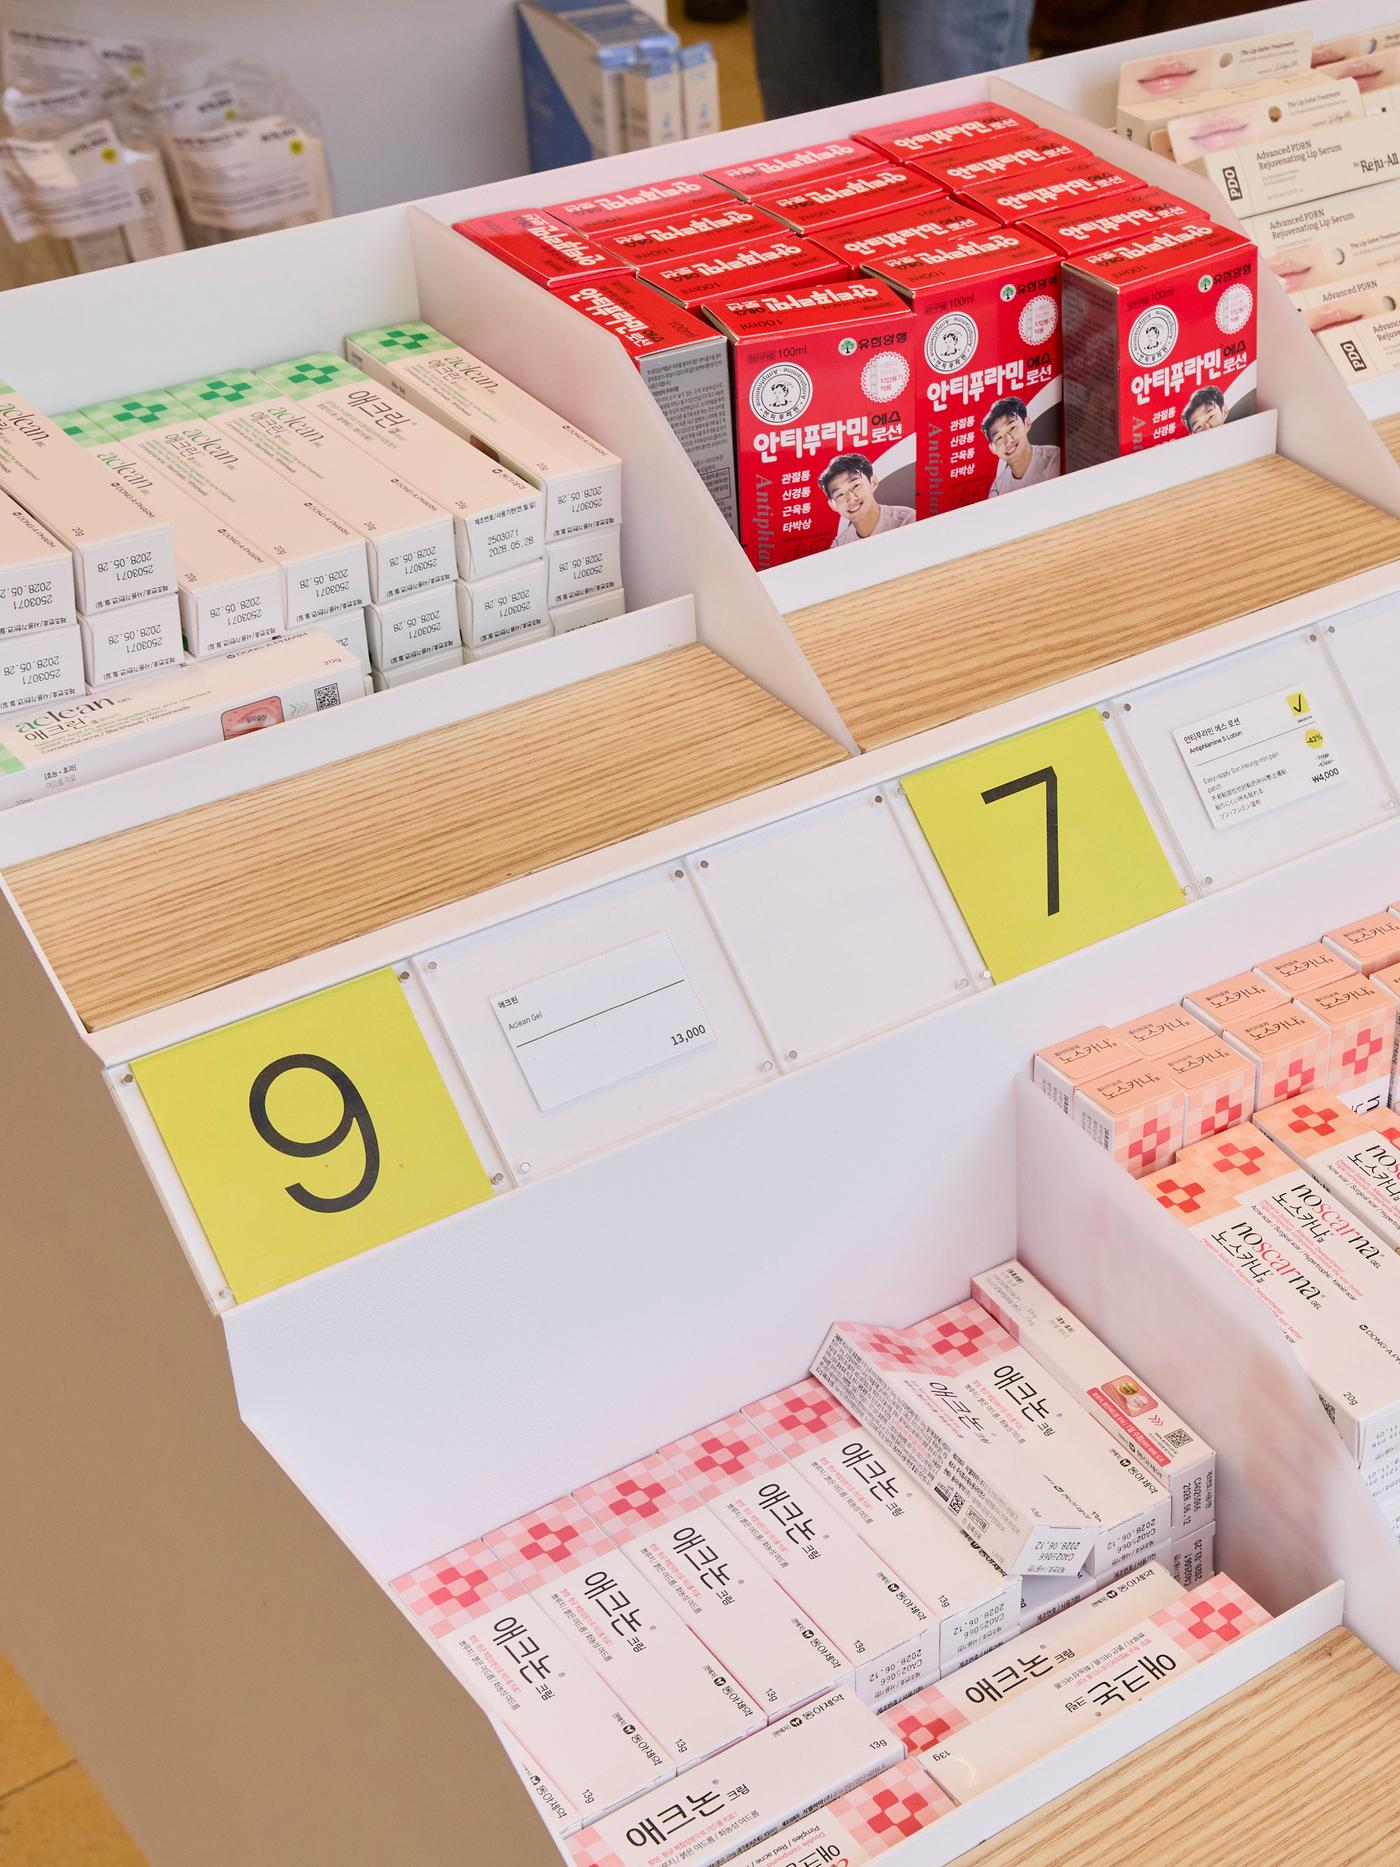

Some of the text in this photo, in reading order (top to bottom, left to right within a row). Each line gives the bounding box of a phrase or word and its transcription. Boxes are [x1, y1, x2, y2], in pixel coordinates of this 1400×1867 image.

[1256, 143, 1291, 161] Advanced
[1258, 144, 1342, 171] Rejuvenating Lip Serum
[1360, 153, 1399, 173] Reju-All
[1222, 166, 1243, 201] PDO
[1269, 213, 1304, 231] Advanced
[1271, 212, 1355, 240] Rejuvenating Serum
[1017, 275, 1058, 296] 유한양행
[1213, 264, 1252, 286] 유한양행
[1322, 285, 1355, 302] Advanced
[570, 287, 650, 335] 안티푸라민
[777, 345, 807, 358] 100ml
[858, 332, 908, 351] 유한양행
[1340, 341, 1367, 371] PDO
[445, 356, 498, 391] aclean
[927, 353, 1052, 413] 안티푸라민 에스 로션
[1131, 340, 1247, 406] 안티푸라민 에스 로션
[348, 390, 412, 430] 애크린
[1152, 407, 1176, 424] 관절통
[268, 406, 324, 443] aclean
[950, 416, 975, 432] 관절통
[1152, 422, 1176, 439] 신경통
[183, 428, 239, 465] aclean
[753, 412, 902, 464] 안티푸라민 에스 로션
[950, 431, 975, 447] 신경통
[950, 448, 975, 464] 근육통
[97, 452, 152, 490] aclean
[781, 470, 811, 484] 관절통
[950, 463, 975, 479] 타박상
[781, 486, 812, 501] 신경통
[781, 503, 812, 517] 근육통
[488, 529, 519, 545] 2503071
[782, 519, 812, 532] 타박상
[1183, 717, 1241, 745] 안티푸라민 에스 로션
[1189, 737, 1222, 754] Antiphlamine
[1226, 730, 1242, 740] Lotion
[980, 765, 1059, 916] 7
[498, 995, 519, 1009] 애크린
[508, 1011, 544, 1030] Aclean Gel
[670, 1024, 706, 1046] 13,000
[249, 1053, 380, 1214] 9
[1272, 1193, 1331, 1239] 노스카나
[1290, 1182, 1382, 1261] noscarna
[1211, 1232, 1272, 1280] 노스카나
[1231, 1221, 1322, 1303] noscarna
[993, 1365, 1050, 1423] 애크논
[1343, 1391, 1359, 1407] 20g
[841, 1442, 905, 1517] 애크논 크림
[758, 1483, 821, 1560] 애크논 크림
[673, 1526, 736, 1606] 애크논 크림
[1118, 1567, 1156, 1594] 동아제약
[584, 1571, 647, 1653] 애크논 크림
[937, 1595, 950, 1608] 13g
[492, 1616, 555, 1701] 애크논 크림
[853, 1640, 866, 1653] 13g
[965, 1654, 1055, 1705] 애크논
[1087, 1653, 1177, 1707] 애크논
[764, 1687, 779, 1701] 13g
[802, 1693, 846, 1722] 동아제약
[631, 1733, 663, 1766] 동아제약
[674, 1738, 688, 1753] 13g
[869, 1739, 888, 1750] 13g
[536, 1785, 568, 1819] 동아제약
[582, 1788, 595, 1803] 13g
[625, 1783, 750, 1846] 애크논 크림
[792, 1825, 820, 1842] Pimples
